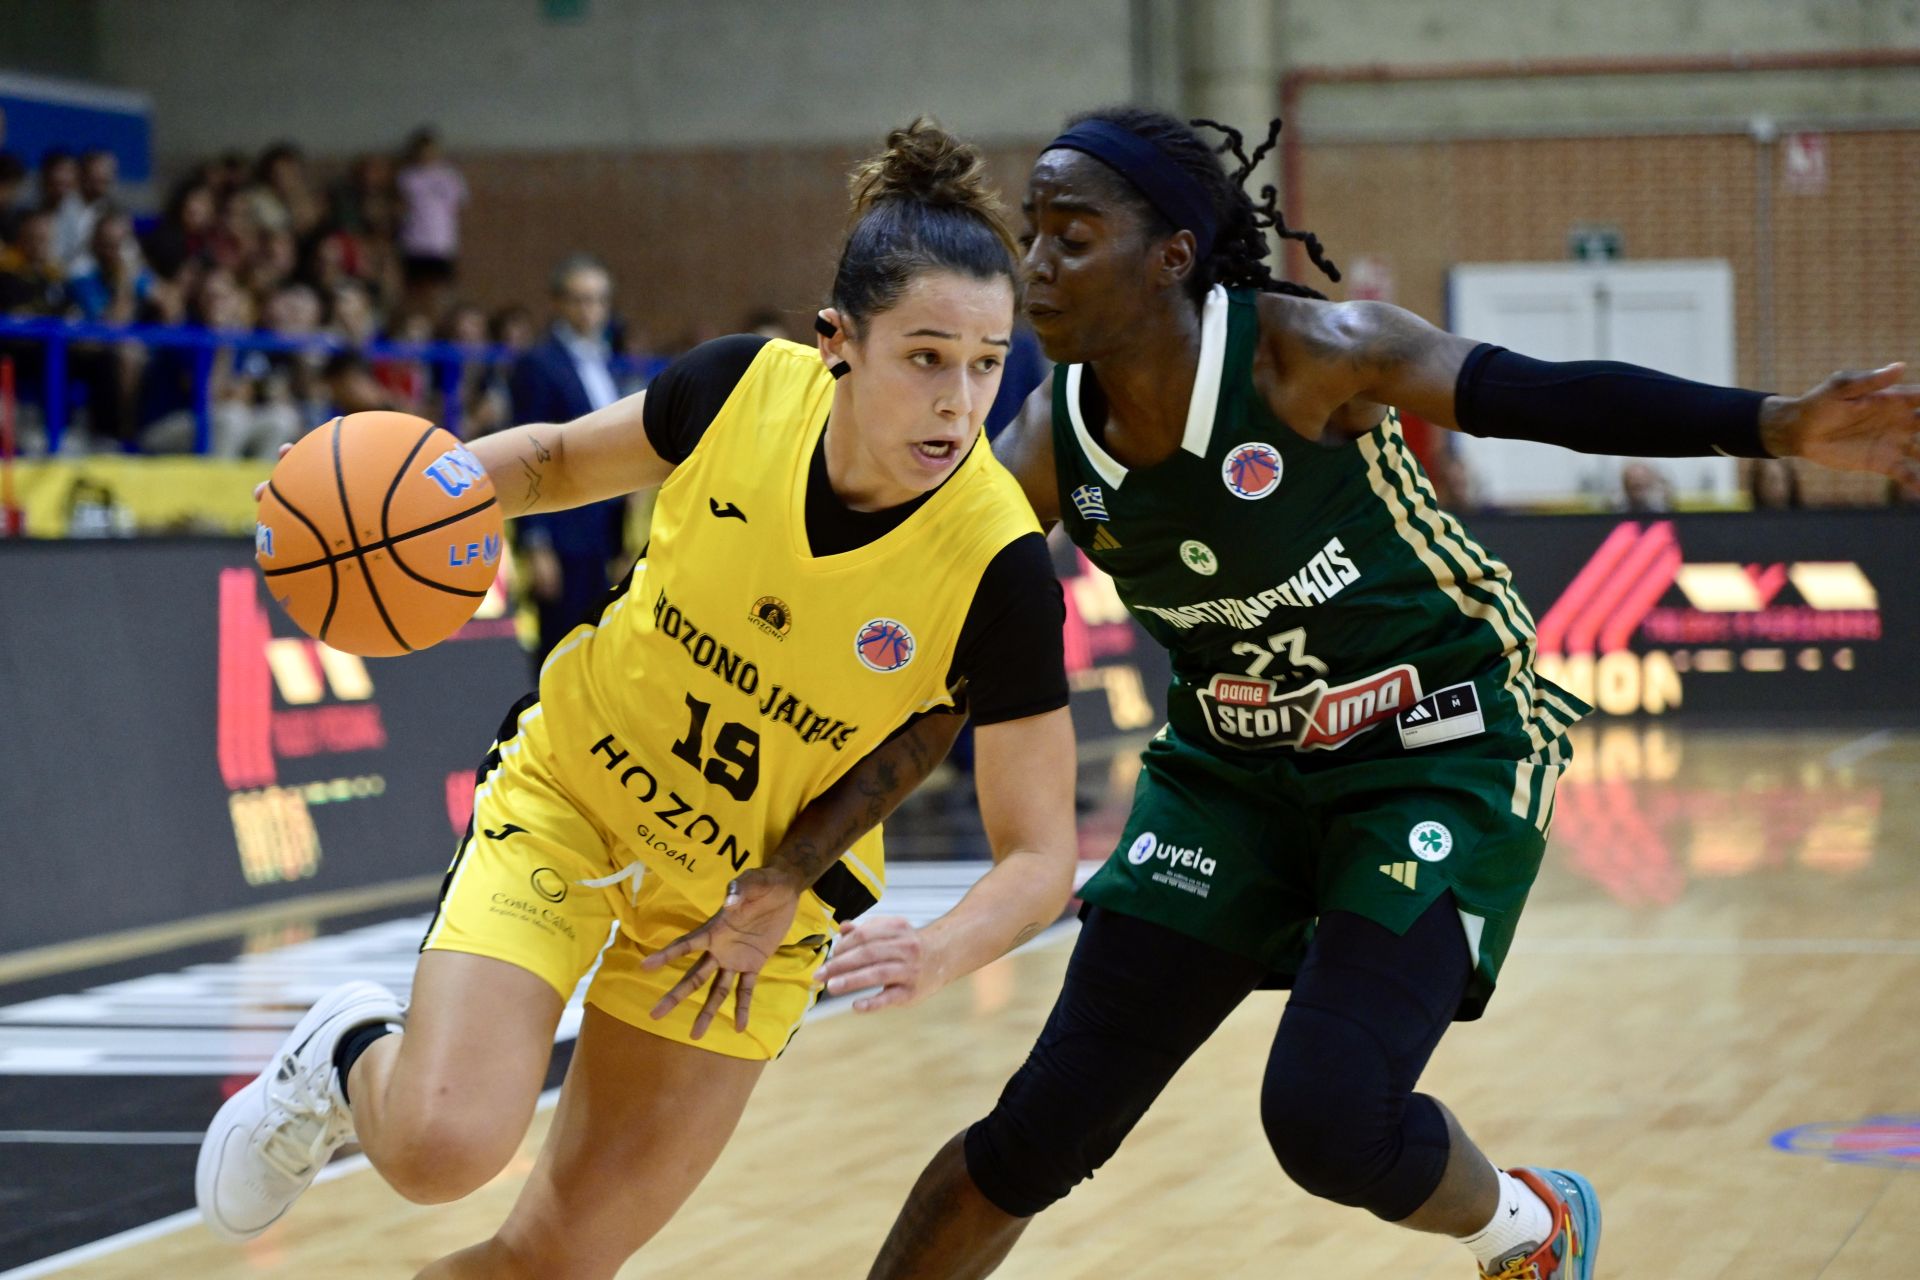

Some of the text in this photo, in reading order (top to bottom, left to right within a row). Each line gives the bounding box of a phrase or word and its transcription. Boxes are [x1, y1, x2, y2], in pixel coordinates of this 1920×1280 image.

[653, 586, 760, 696] HOZONO
[1219, 682, 1263, 704] pame
[670, 690, 760, 802] 19
[636, 823, 696, 874] GLOBAL
